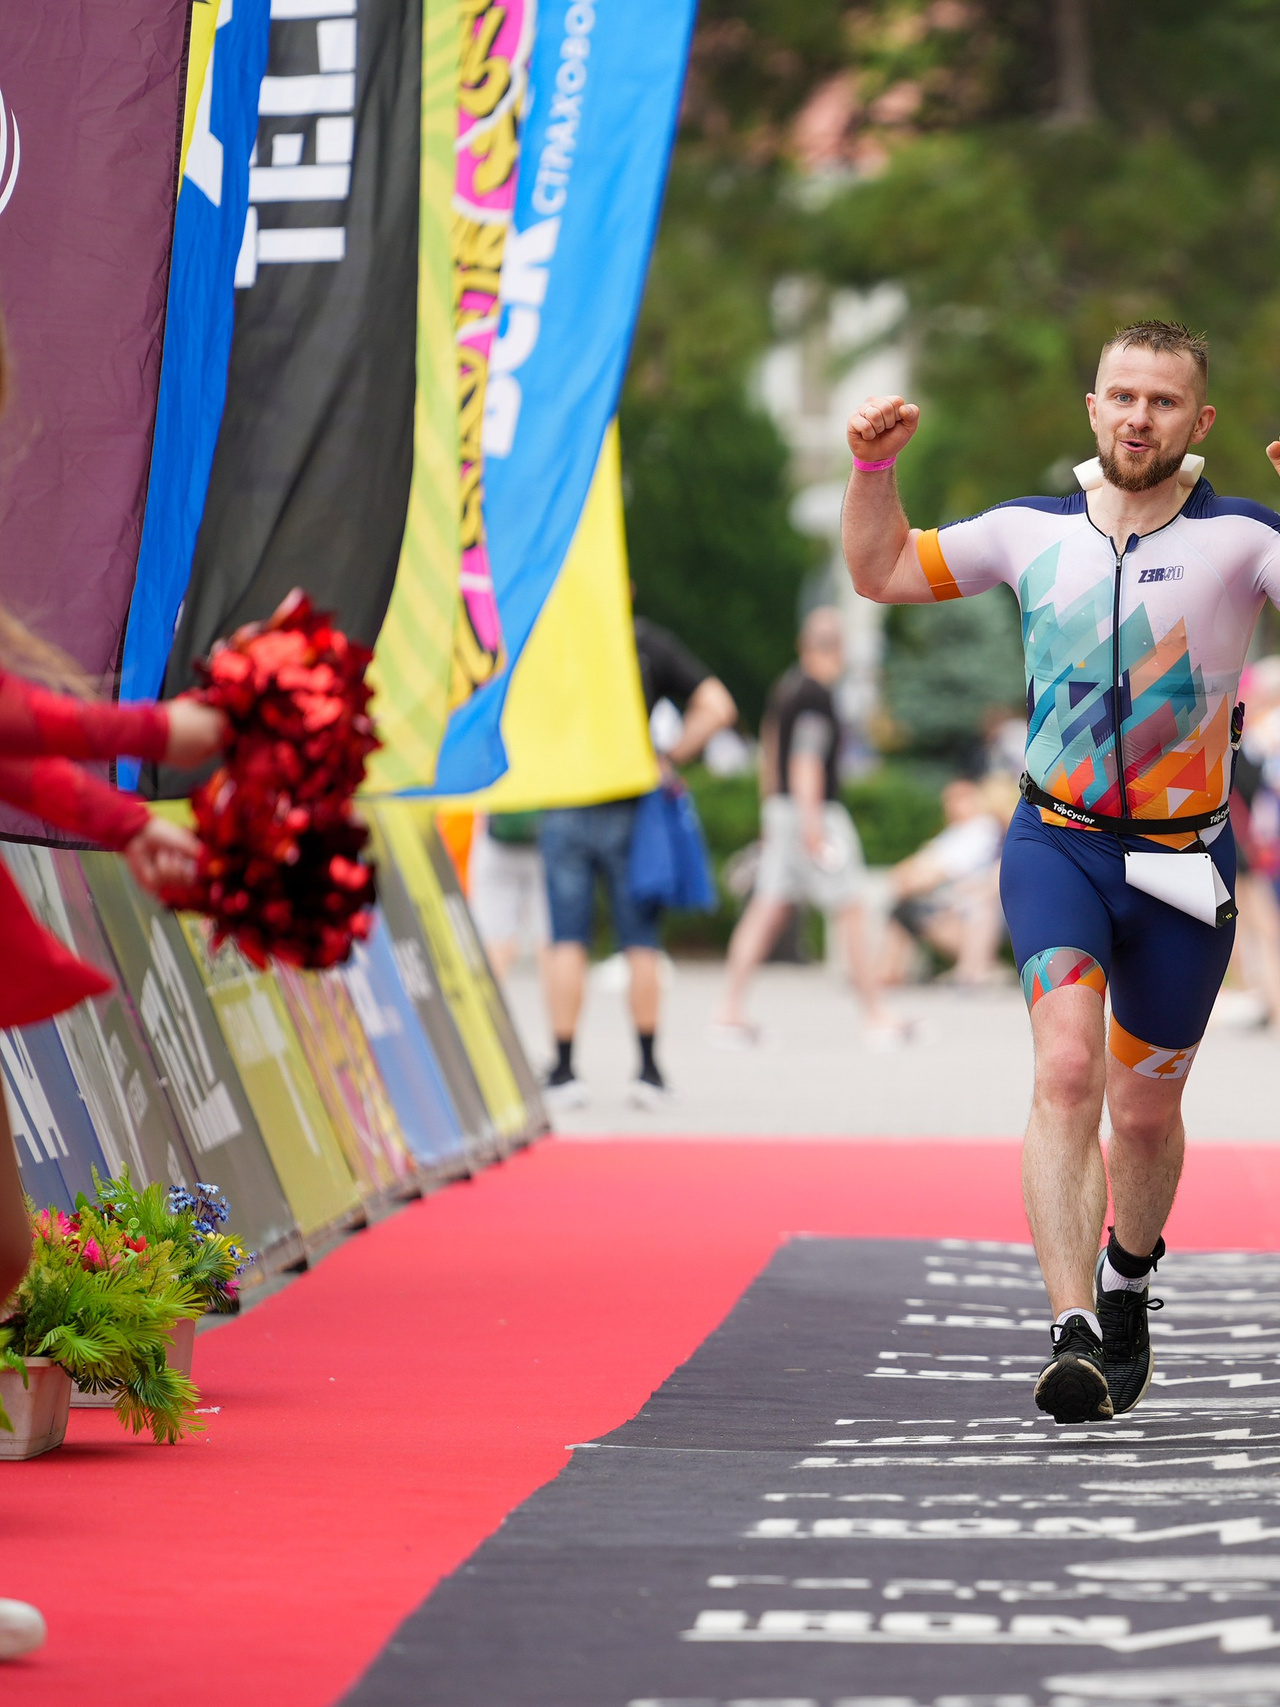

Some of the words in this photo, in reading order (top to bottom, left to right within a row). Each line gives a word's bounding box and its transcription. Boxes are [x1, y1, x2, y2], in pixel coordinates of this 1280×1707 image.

[531, 0, 597, 215] СТРАХОВО
[1053, 802, 1096, 825] TopCycler
[825, 1430, 1145, 1445] IRON
[798, 1453, 1138, 1466] IRON
[752, 1516, 1136, 1536] IRON
